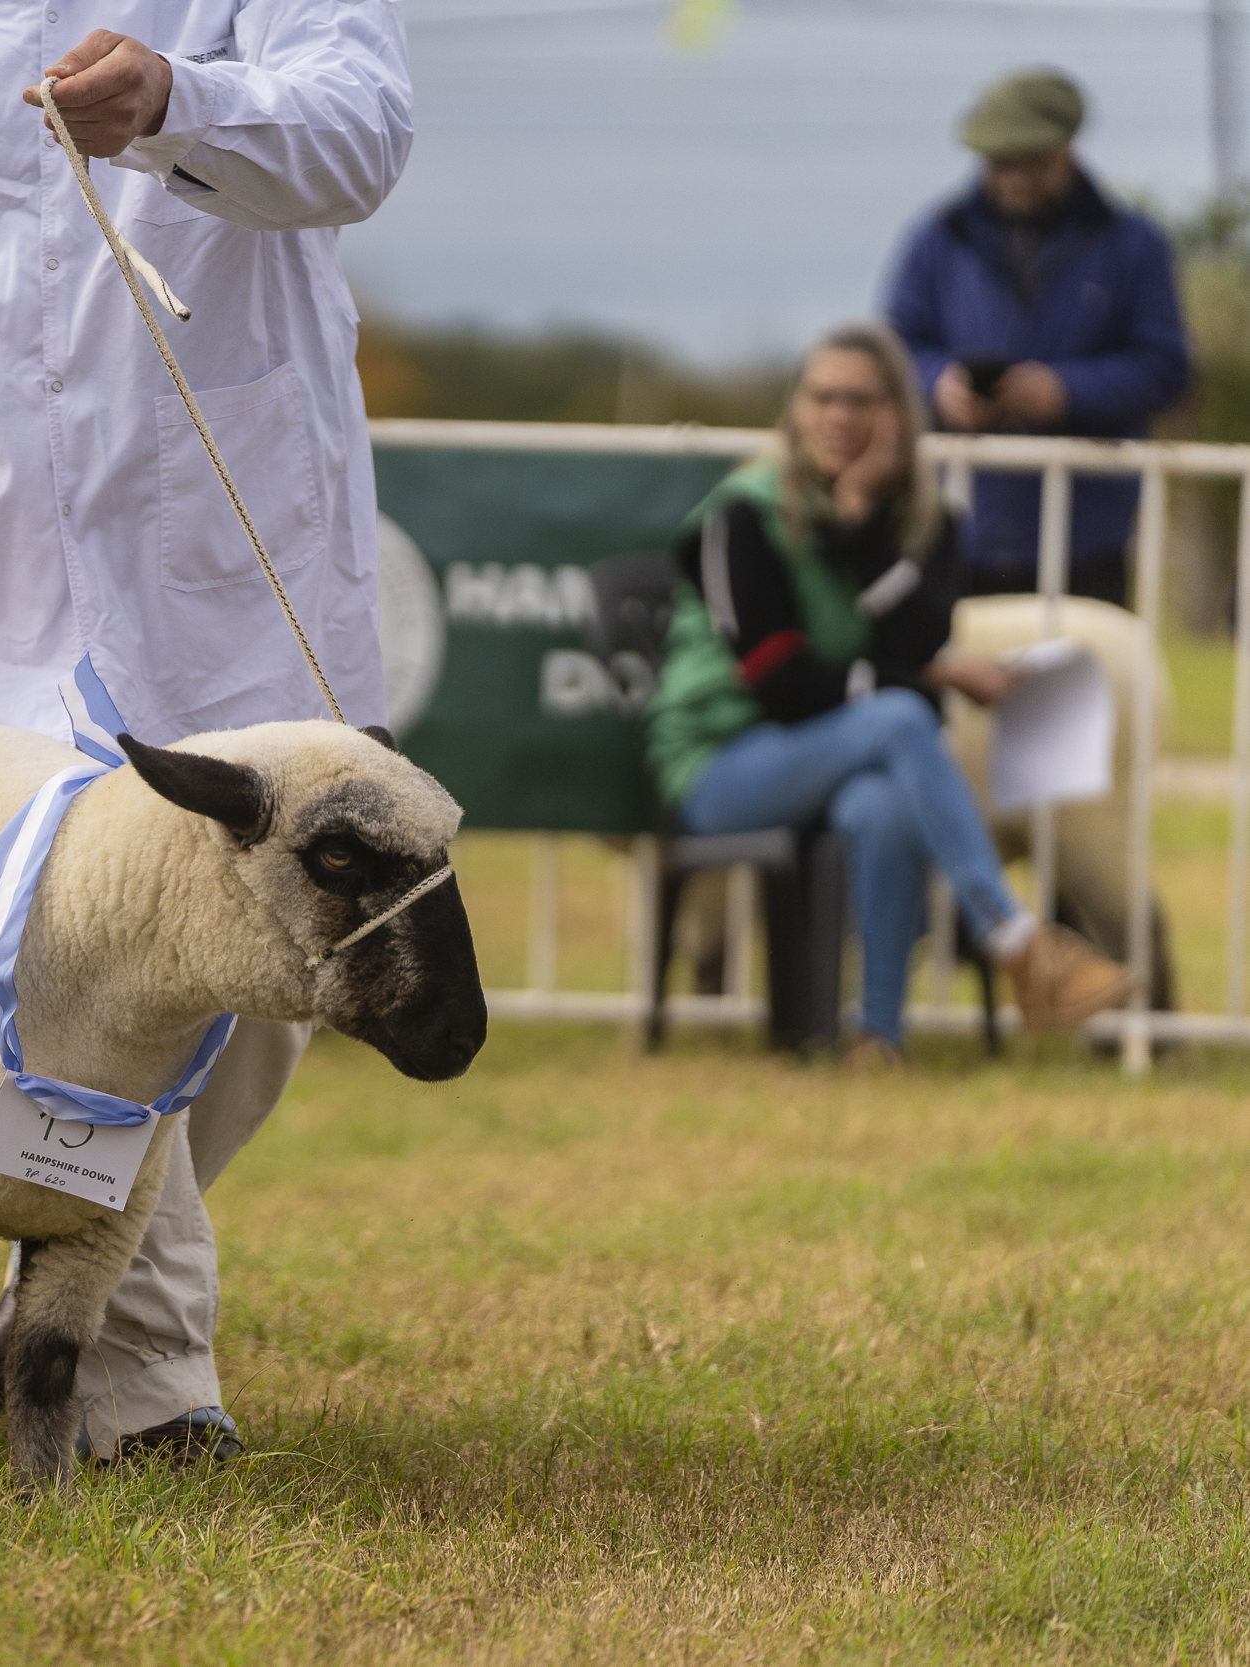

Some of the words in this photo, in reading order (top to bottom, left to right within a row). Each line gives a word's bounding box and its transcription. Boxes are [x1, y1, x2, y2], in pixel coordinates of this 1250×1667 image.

[20, 1151, 81, 1174] HAMPSHIRE
[81, 1168, 116, 1185] DOWN
[44, 1174, 66, 1186] 620
